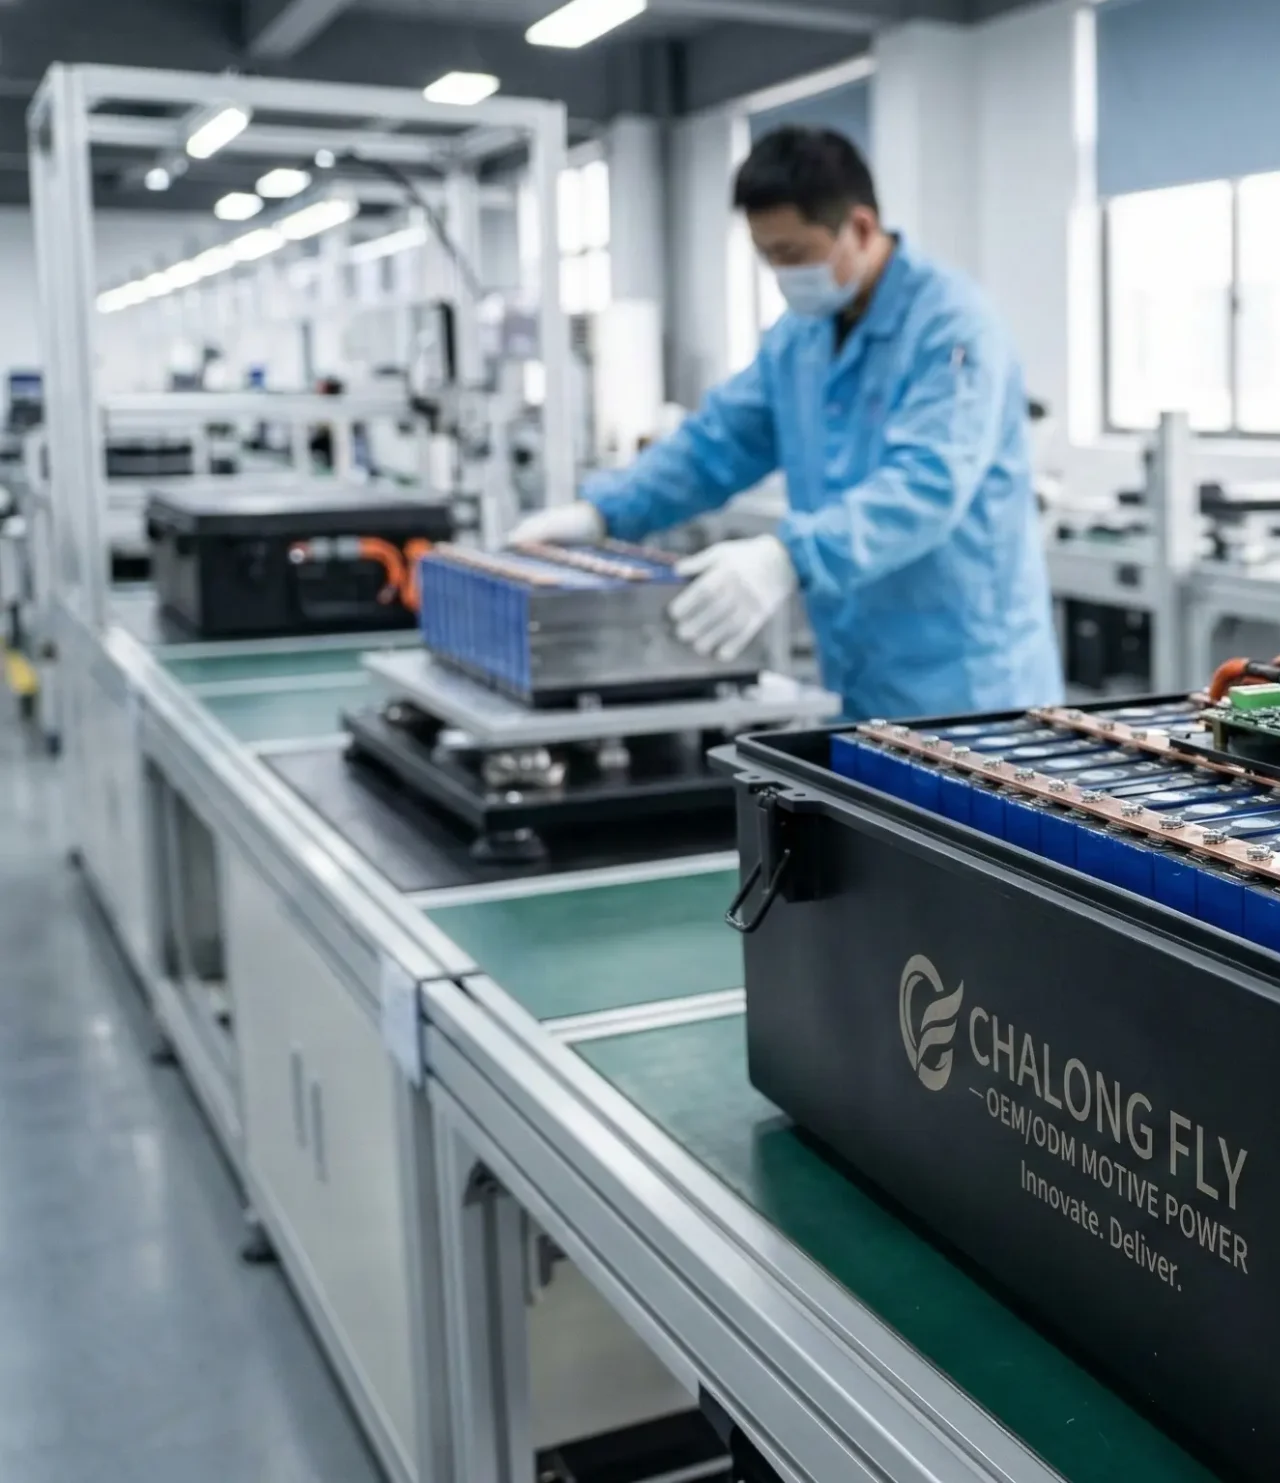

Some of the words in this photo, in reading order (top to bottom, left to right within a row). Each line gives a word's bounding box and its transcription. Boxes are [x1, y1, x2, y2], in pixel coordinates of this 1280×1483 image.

[969, 1006, 1153, 1160] CHALONG
[1170, 1110, 1248, 1210] FLY
[986, 1087, 1076, 1168] OEM/ODM
[1082, 1143, 1159, 1219] MOTIVE
[1166, 1194, 1248, 1274] POWER
[1021, 1160, 1104, 1239] Innovate.
[1110, 1217, 1182, 1292] Deliver.
